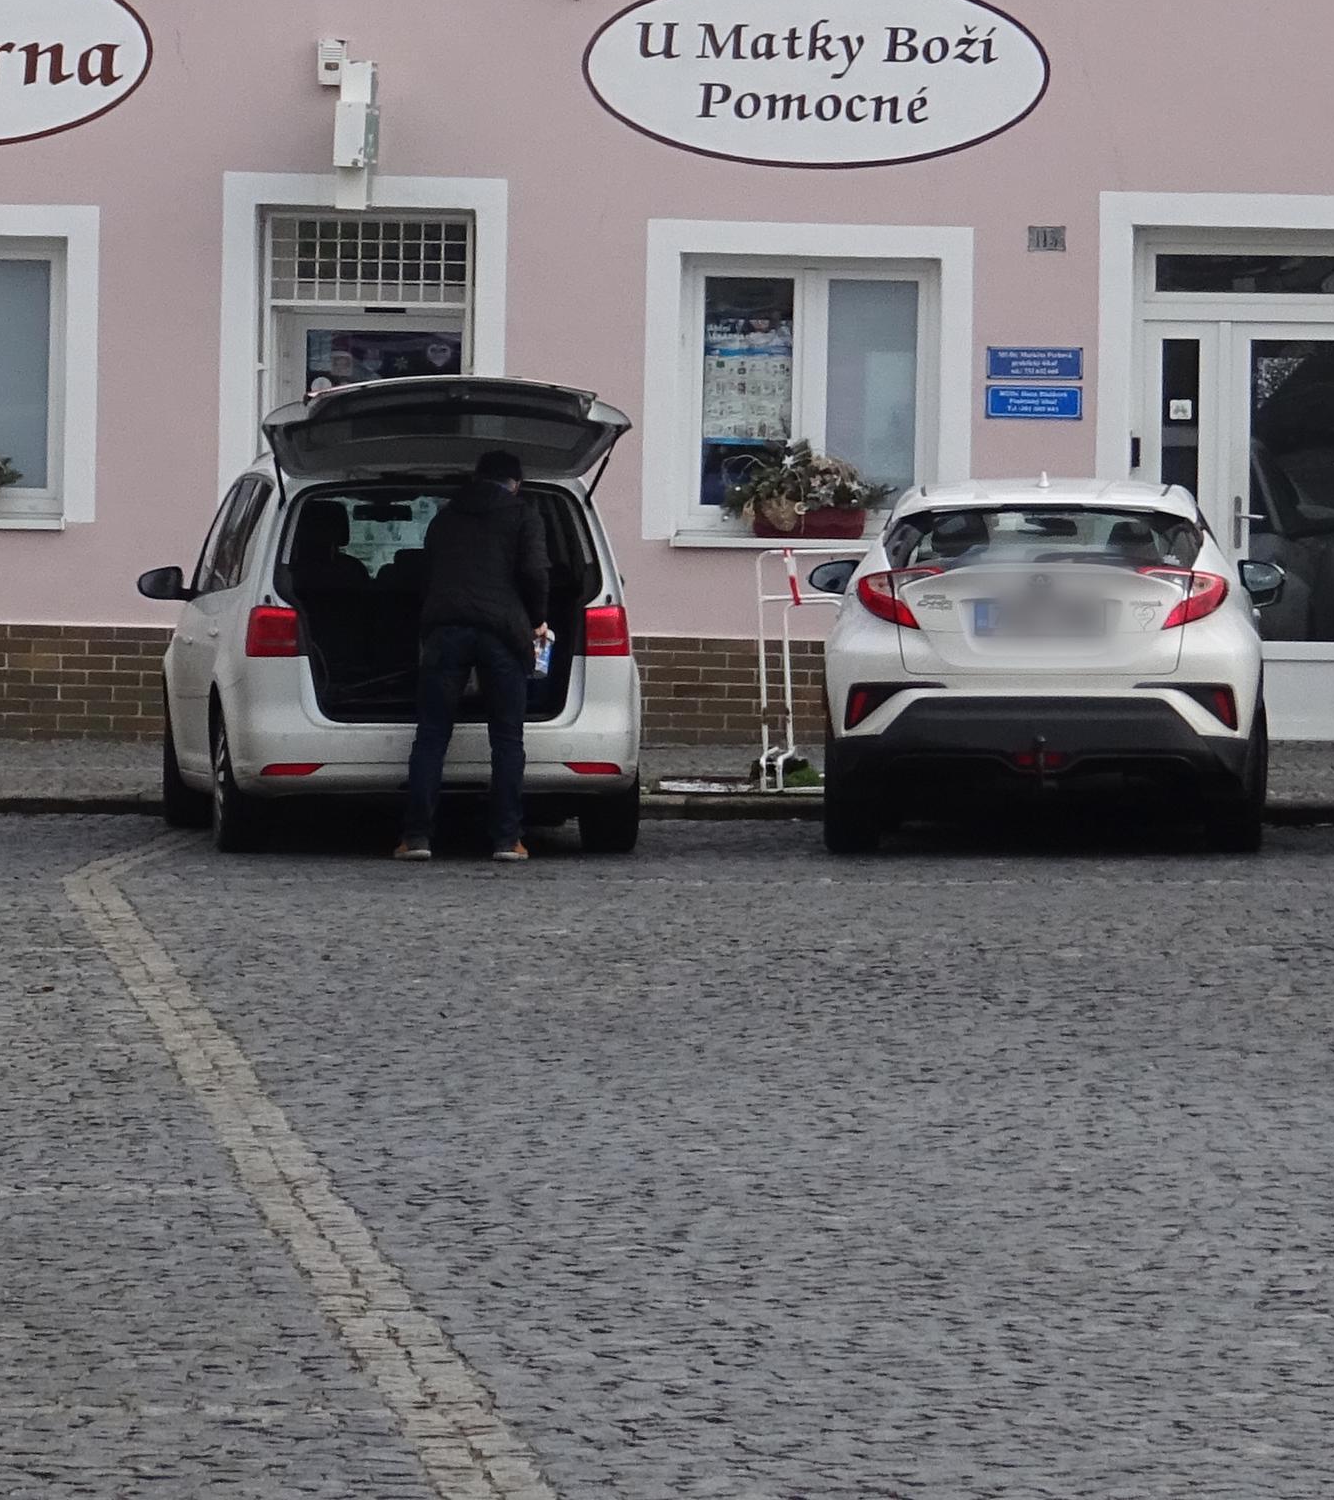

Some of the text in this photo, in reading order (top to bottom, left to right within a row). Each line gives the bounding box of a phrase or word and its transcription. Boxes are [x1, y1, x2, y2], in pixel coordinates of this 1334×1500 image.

[636, 19, 1000, 80] U Matky Boží
[696, 82, 930, 126] Pomocné
